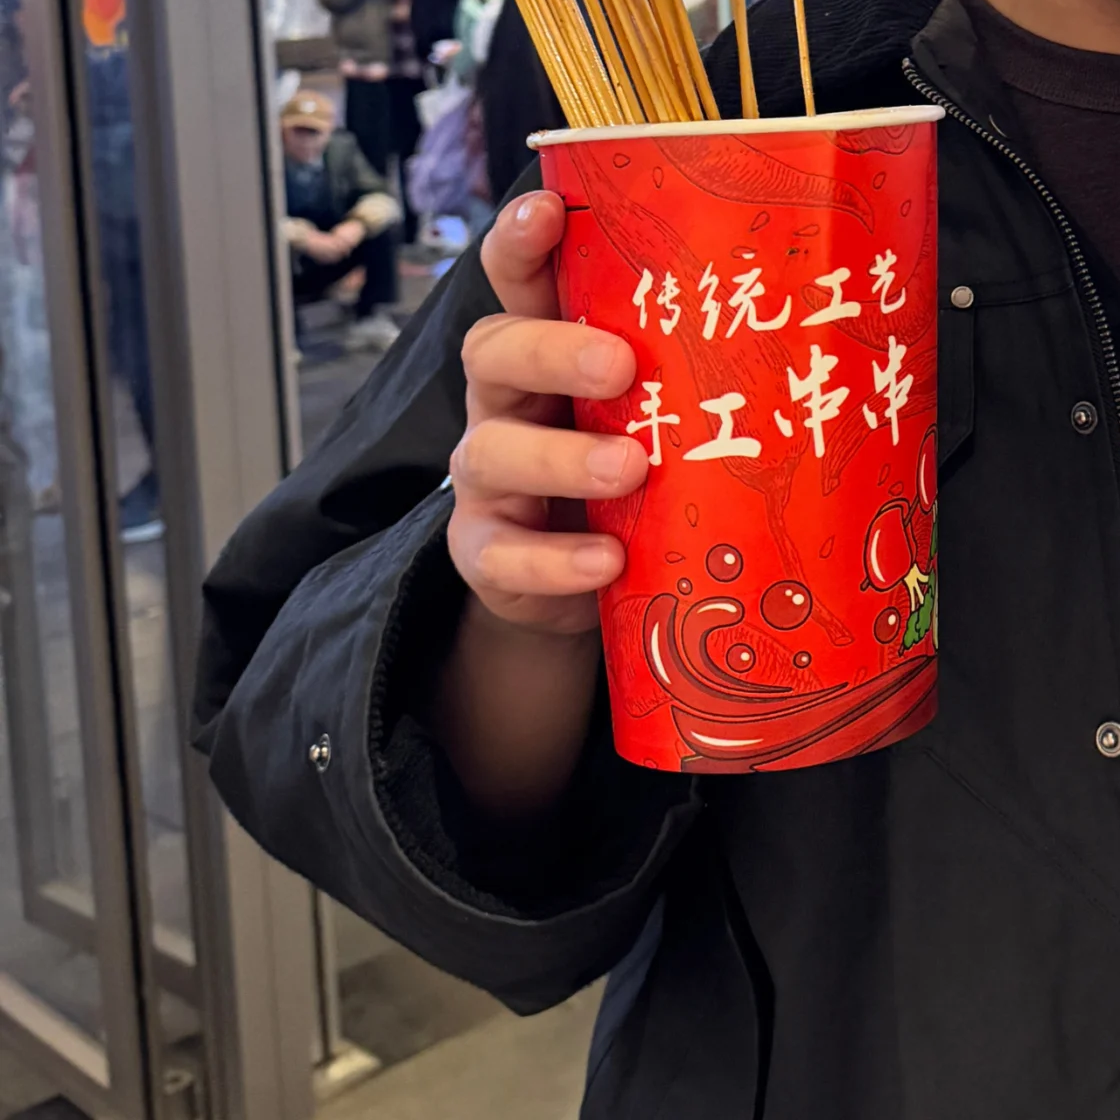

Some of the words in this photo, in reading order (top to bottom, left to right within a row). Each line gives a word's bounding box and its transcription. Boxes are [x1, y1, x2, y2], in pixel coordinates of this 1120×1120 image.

[632, 249, 906, 340] 传统工艺
[625, 335, 914, 466] 手工串串
